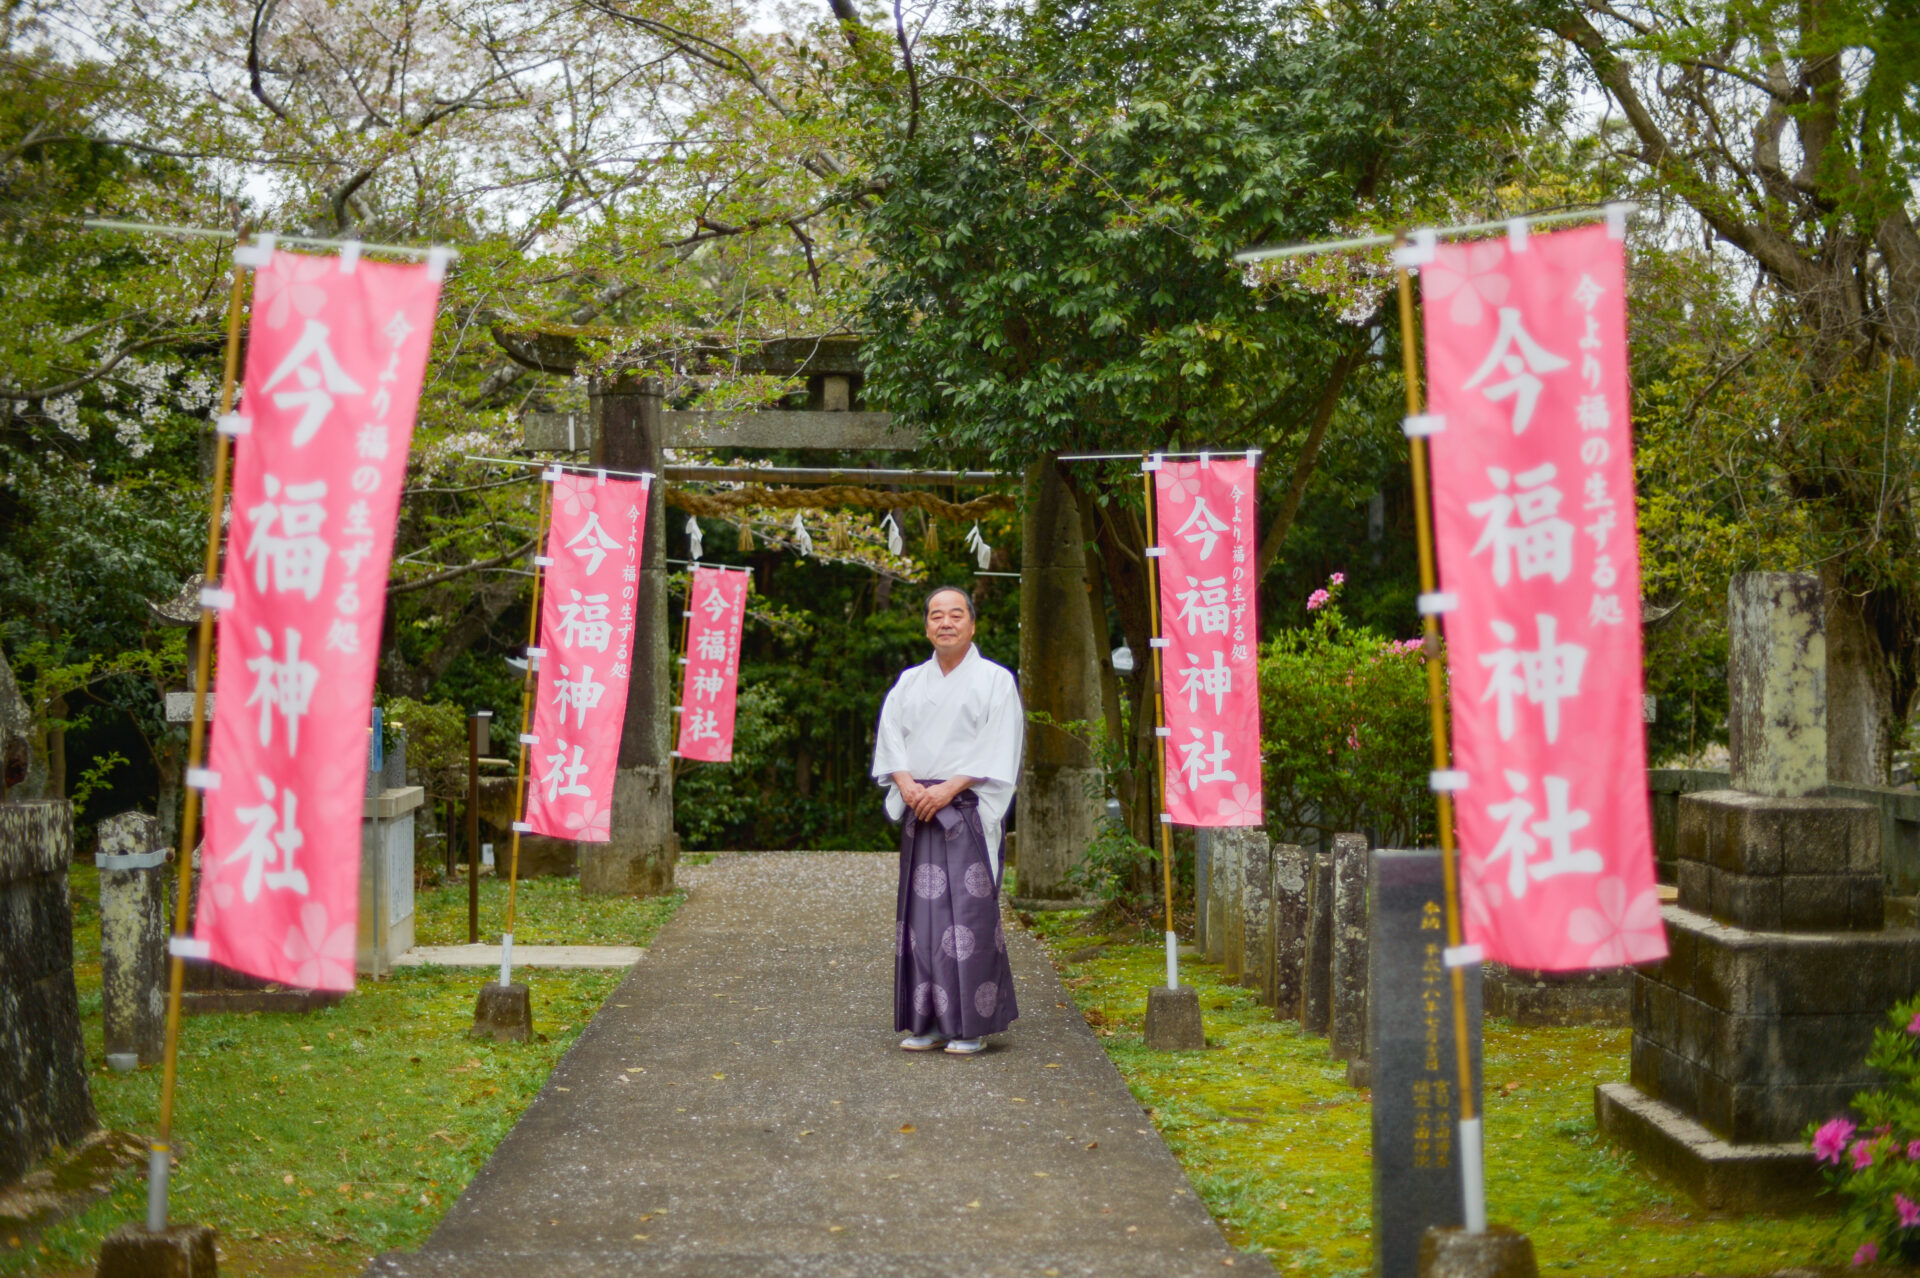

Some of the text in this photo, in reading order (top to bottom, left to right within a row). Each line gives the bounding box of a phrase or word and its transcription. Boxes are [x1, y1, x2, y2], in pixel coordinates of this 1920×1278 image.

[325, 310, 416, 654] 今より福の生ずる処
[609, 504, 642, 679] 今より福の生ずる処
[1230, 485, 1248, 660] 今より福の生ずる処
[1573, 274, 1625, 626] 今より福の生ずる処
[223, 317, 365, 903] 今福神社
[541, 511, 623, 802] 今福神社
[688, 587, 731, 742] 今福神社
[1174, 496, 1237, 792] 今福神社
[1461, 306, 1604, 899] 今福神社
